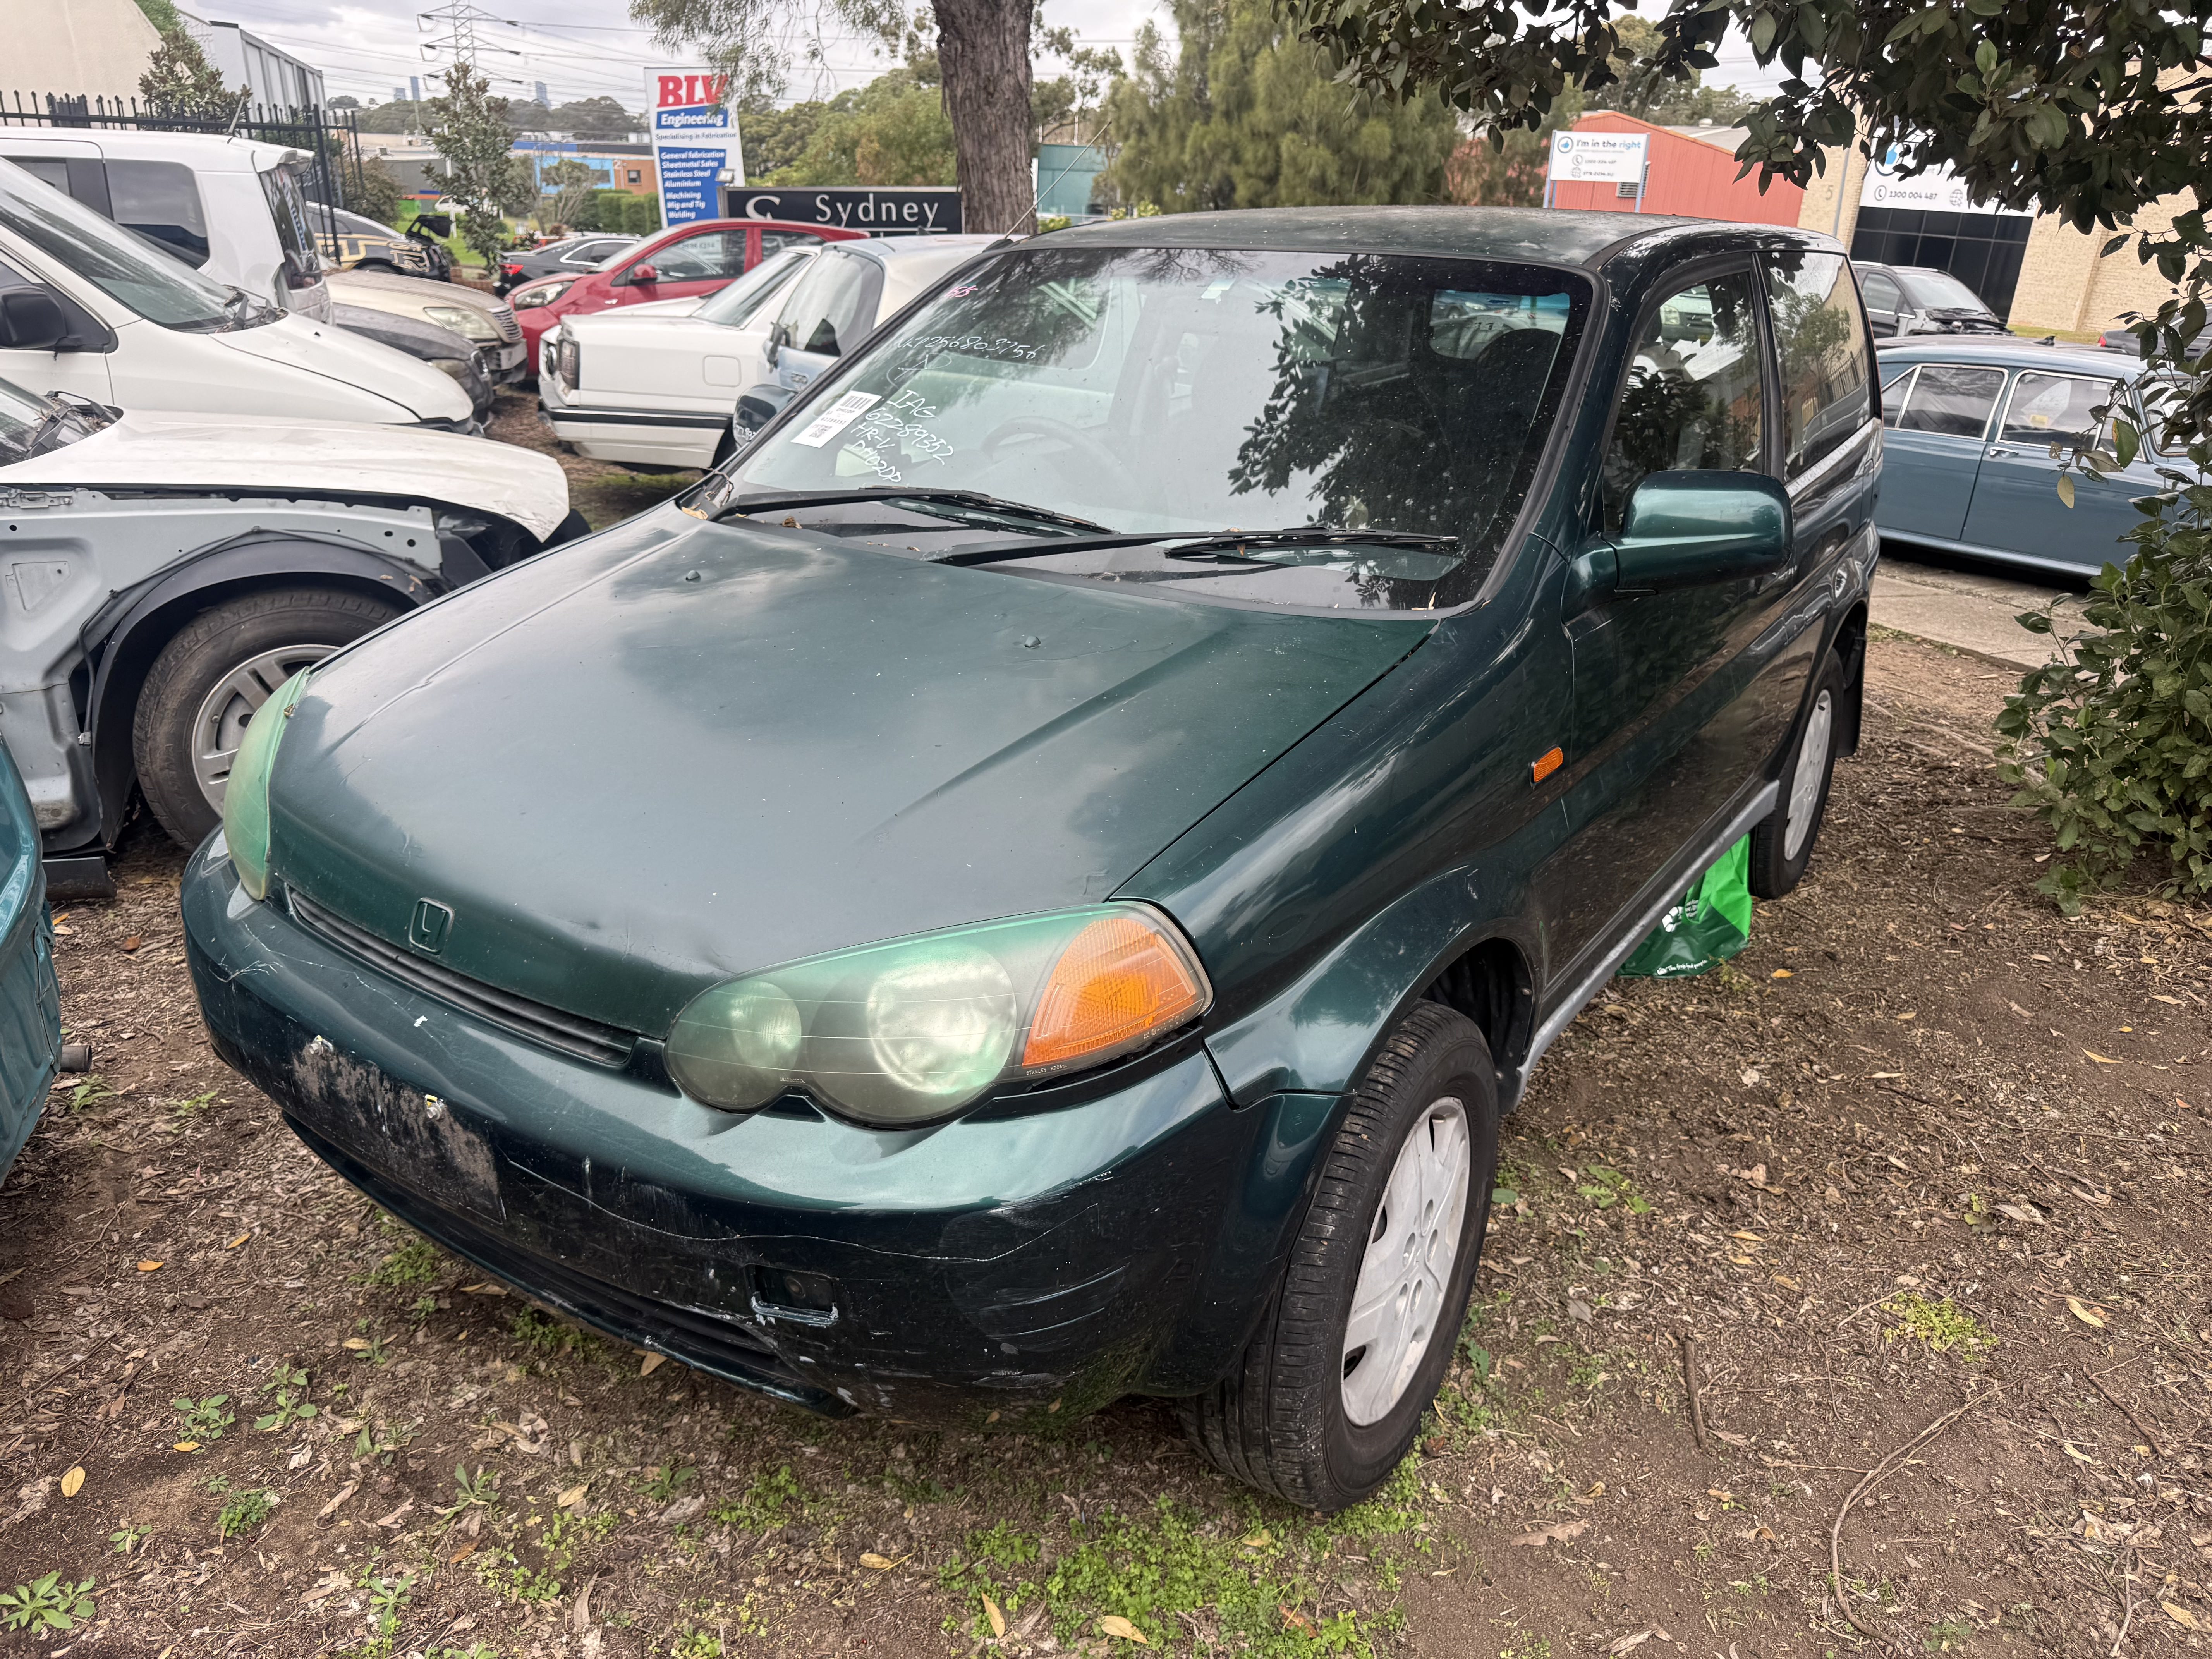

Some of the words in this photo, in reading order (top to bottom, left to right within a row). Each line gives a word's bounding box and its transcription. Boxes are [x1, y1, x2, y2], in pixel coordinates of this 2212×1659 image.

[661, 113, 723, 127] Engineering
[1619, 140, 1641, 150] right
[660, 151, 688, 160] General
[663, 170, 693, 178] Stainless
[1825, 185, 1834, 201] 5
[666, 201, 680, 210] Mig
[694, 200, 706, 209] Tig
[815, 193, 938, 228] Sydney
[668, 211, 696, 219] Welding
[887, 390, 941, 421] IAG
[865, 407, 953, 465] 62289352
[850, 440, 902, 482] DH02DP
